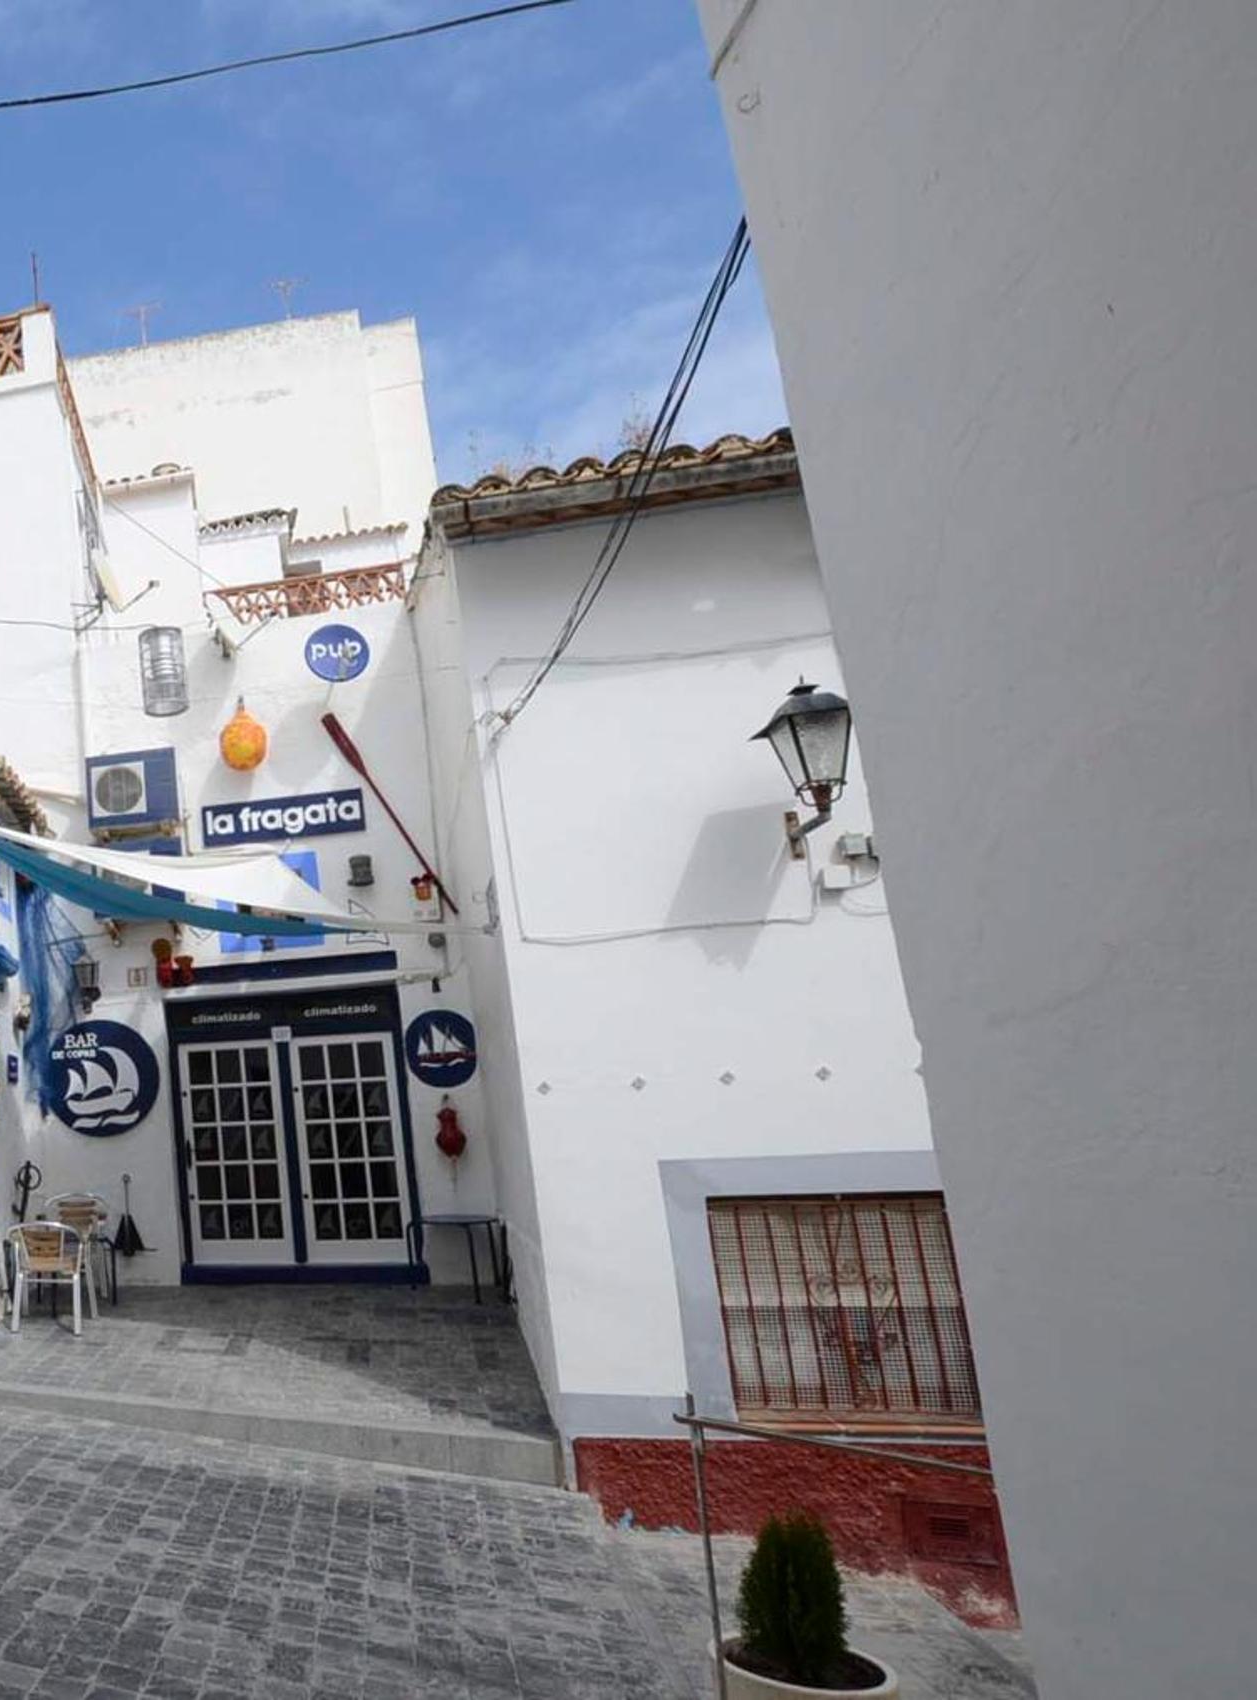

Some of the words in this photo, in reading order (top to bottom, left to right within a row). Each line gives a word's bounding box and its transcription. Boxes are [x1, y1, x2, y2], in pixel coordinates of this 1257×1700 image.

[311, 638, 362, 661] pub
[205, 810, 235, 835] la
[239, 797, 361, 834] fragata
[191, 1010, 262, 1025] climatizado
[303, 1002, 377, 1019] climatizado
[64, 1032, 99, 1049] BAR
[52, 1050, 64, 1060] DE
